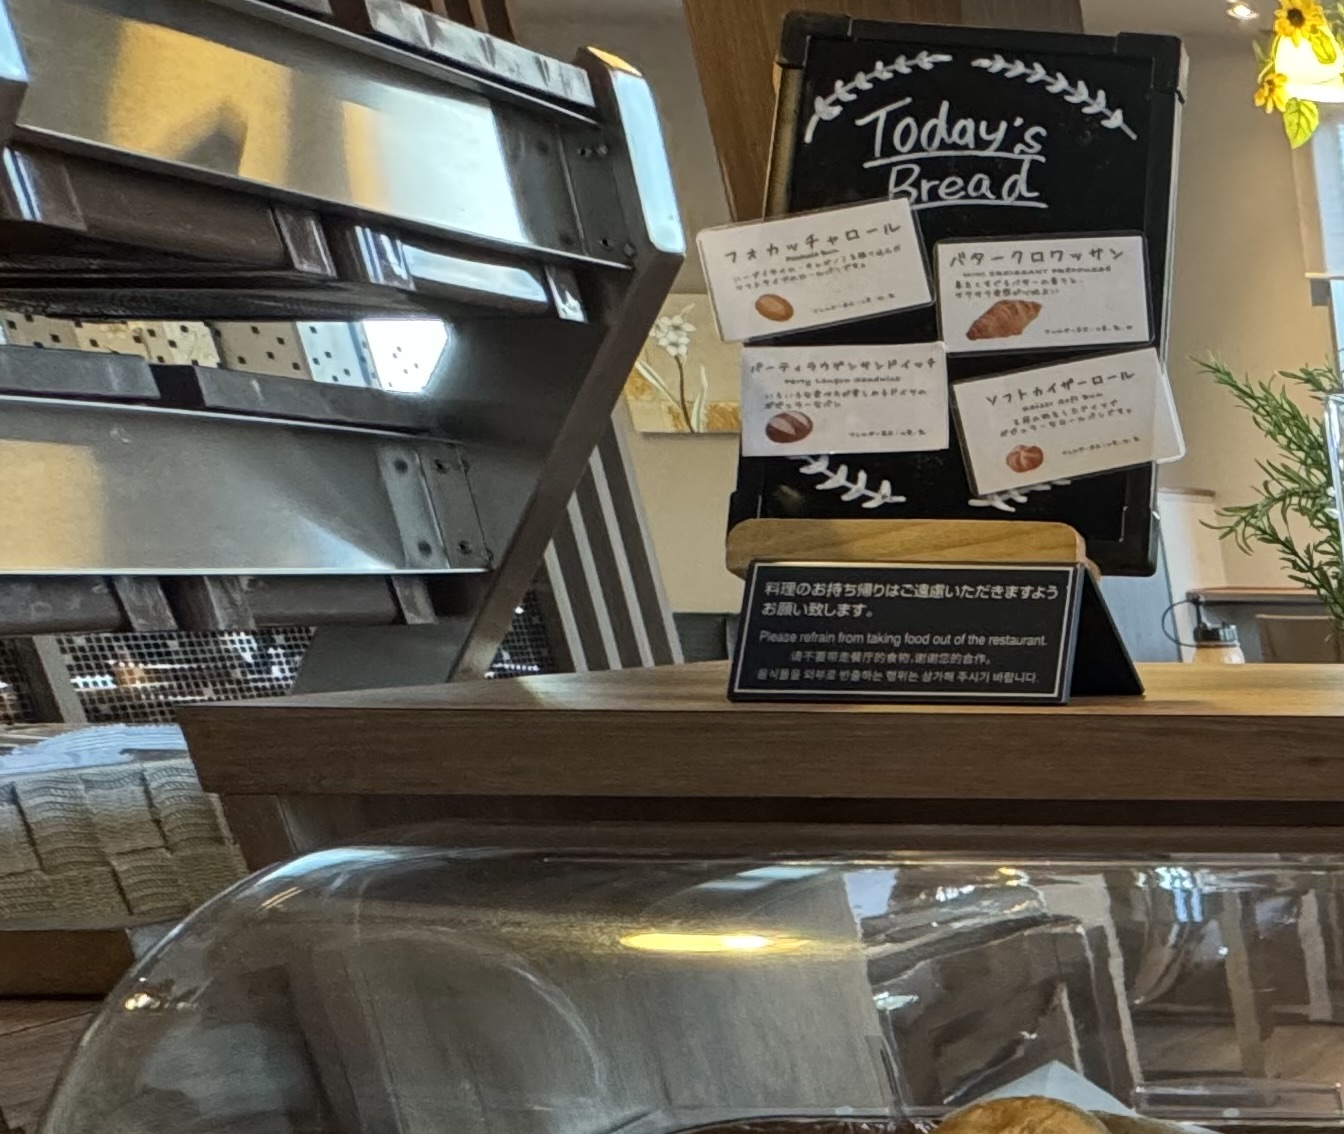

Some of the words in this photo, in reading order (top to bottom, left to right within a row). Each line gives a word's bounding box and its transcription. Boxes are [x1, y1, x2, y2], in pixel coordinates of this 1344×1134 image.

[855, 97, 1048, 157] Today's
[888, 156, 1041, 202] Bread
[950, 248, 1124, 267] バタークロワッサン
[986, 371, 1136, 406] ソフトカイザーロール
[764, 581, 1059, 600] 料理のお持ち帰りはご遠慮いただきますよう
[761, 601, 874, 618] お願い致します。
[759, 630, 797, 643] Please
[800, 631, 835, 644] refrain
[838, 632, 864, 644] from
[867, 632, 902, 647] taking
[904, 632, 930, 645] food
[933, 634, 951, 645] out
[954, 633, 966, 645] of
[968, 634, 986, 645] the
[988, 634, 1048, 646] restaurant.
